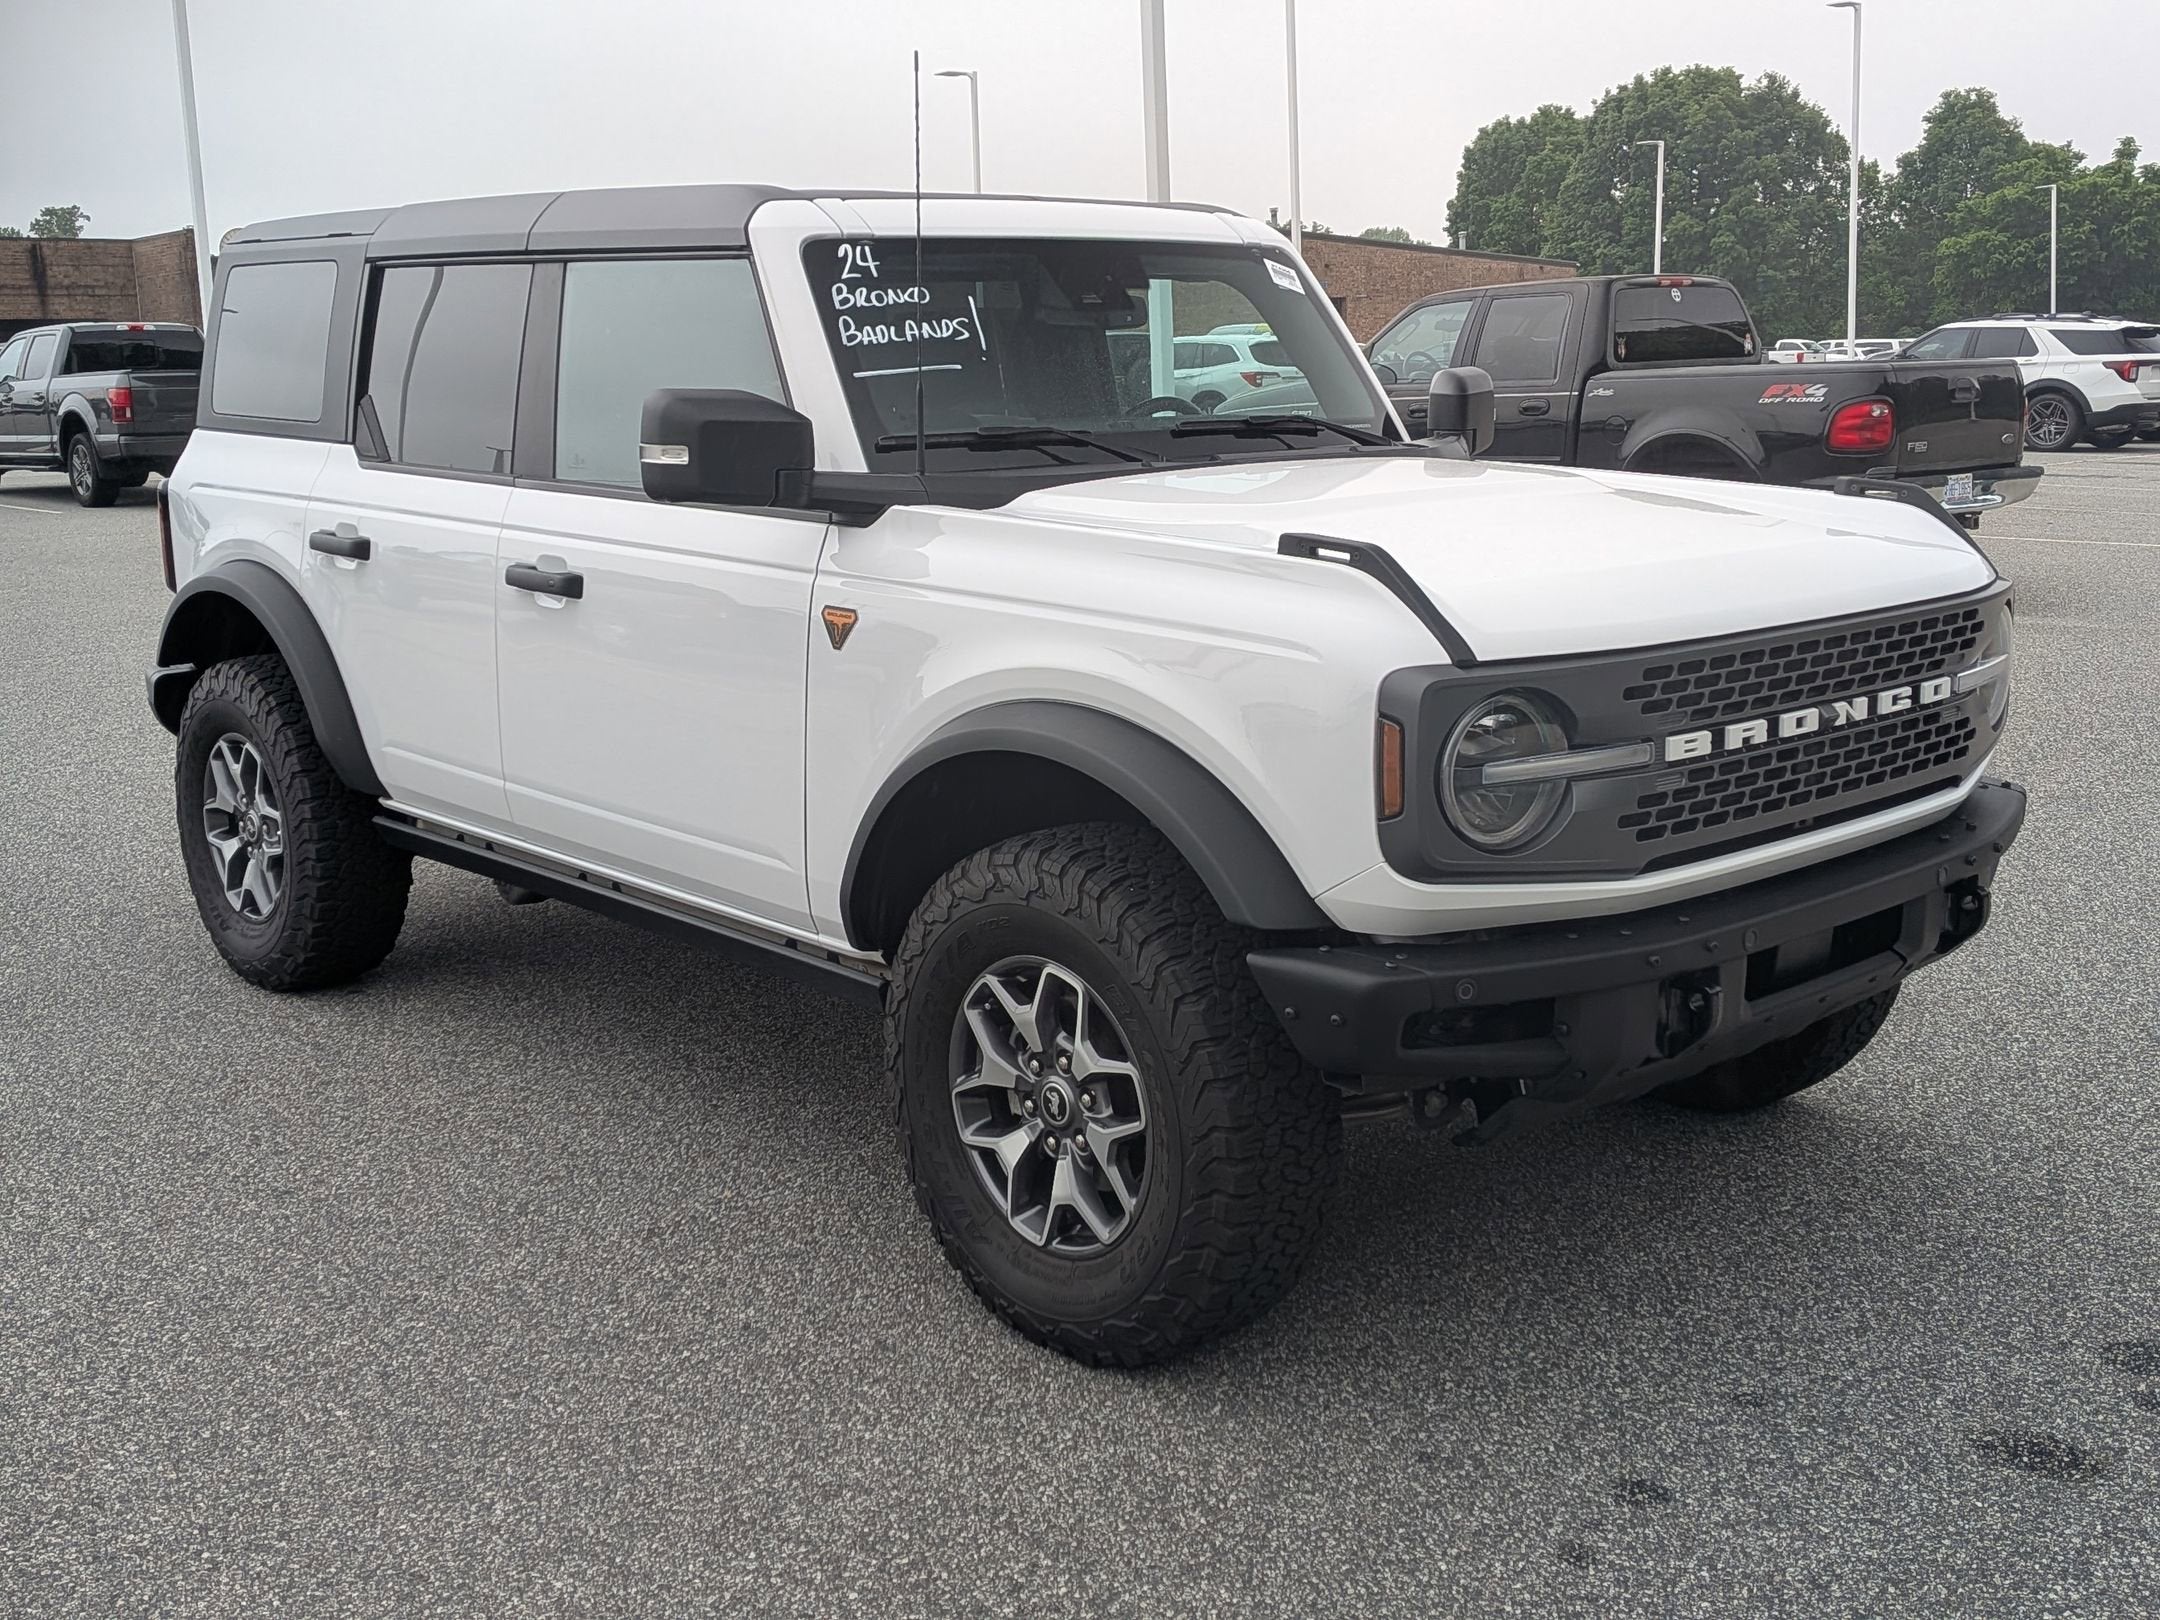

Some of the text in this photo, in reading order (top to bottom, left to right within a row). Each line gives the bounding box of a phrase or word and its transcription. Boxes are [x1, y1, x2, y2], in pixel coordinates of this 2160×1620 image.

[837, 243, 880, 279] 24
[831, 282, 930, 310] BRONCO
[1761, 383, 1829, 398] FX4
[1664, 676, 1951, 762] BRONCO
